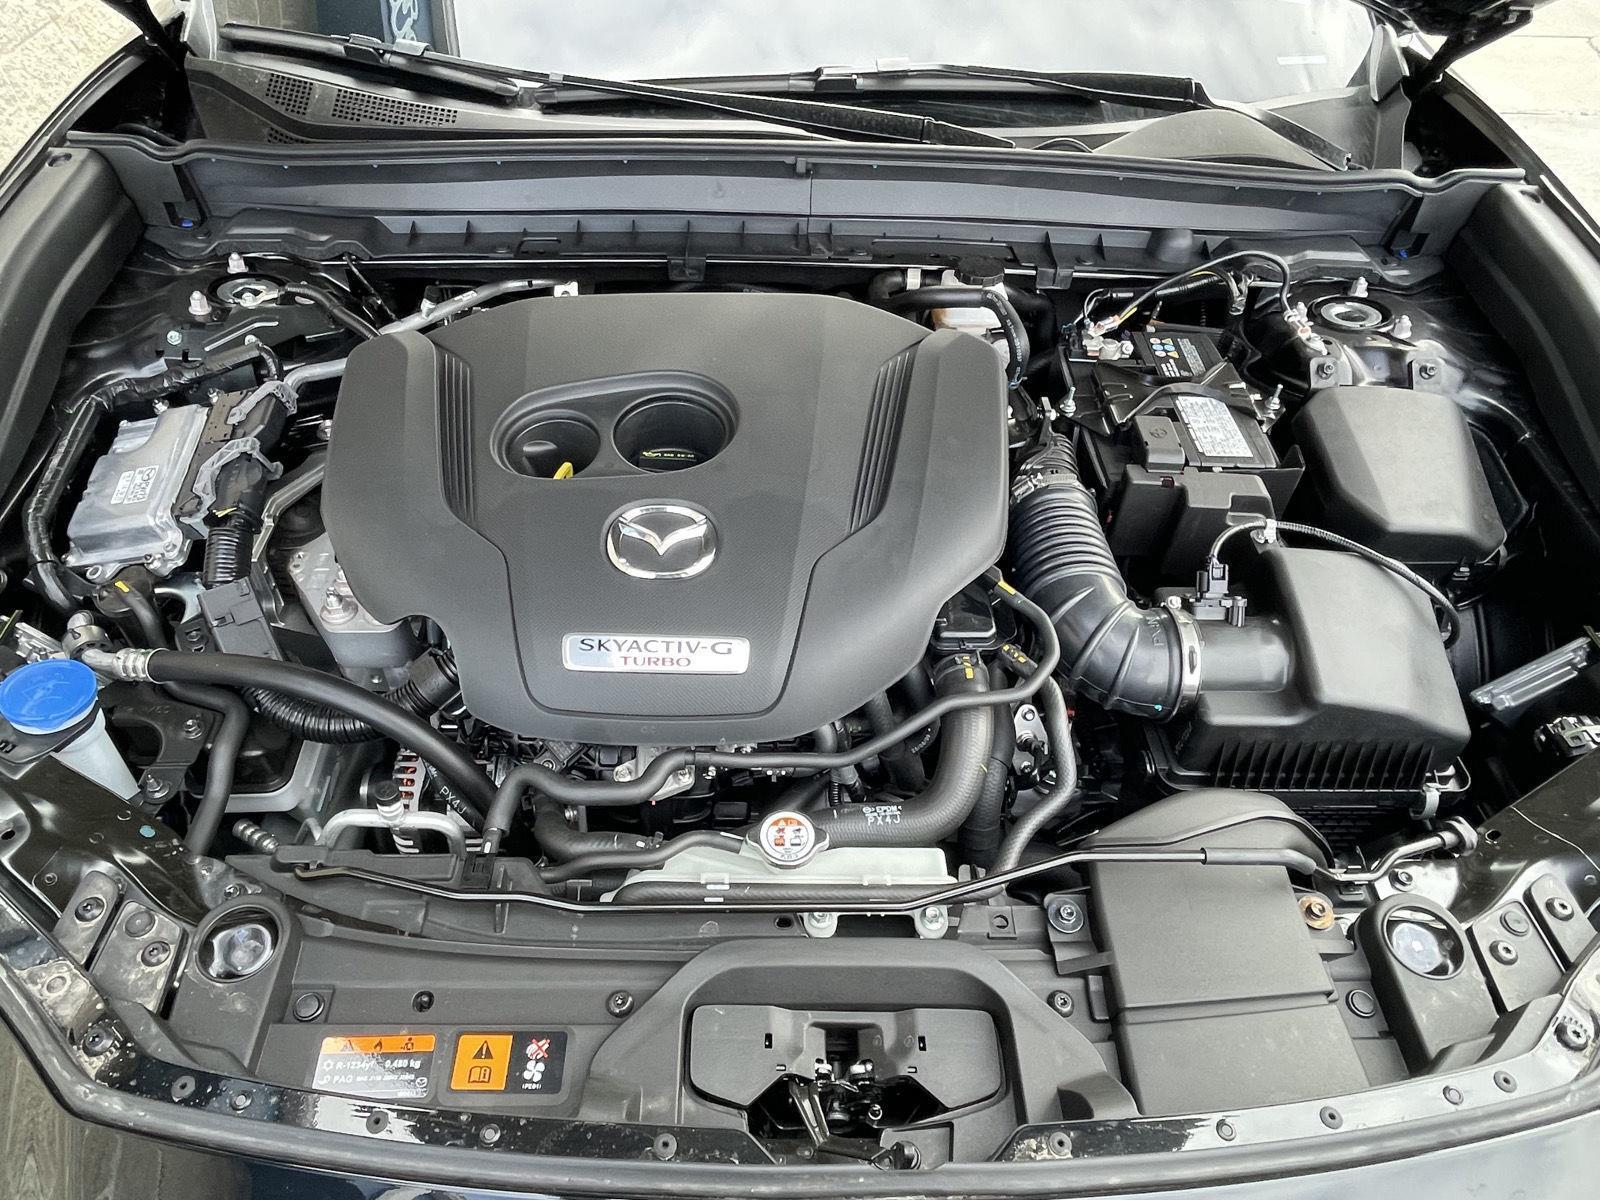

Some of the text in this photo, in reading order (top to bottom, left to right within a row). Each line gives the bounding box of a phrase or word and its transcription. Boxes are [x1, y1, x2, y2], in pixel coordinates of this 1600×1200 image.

[578, 637, 733, 655] SKYACTIV-G
[620, 656, 692, 667] TURBO
[439, 785, 468, 814] PX4J
[867, 814, 901, 826] PX4J
[409, 1058, 422, 1069] kg
[332, 1074, 353, 1084] PAG
